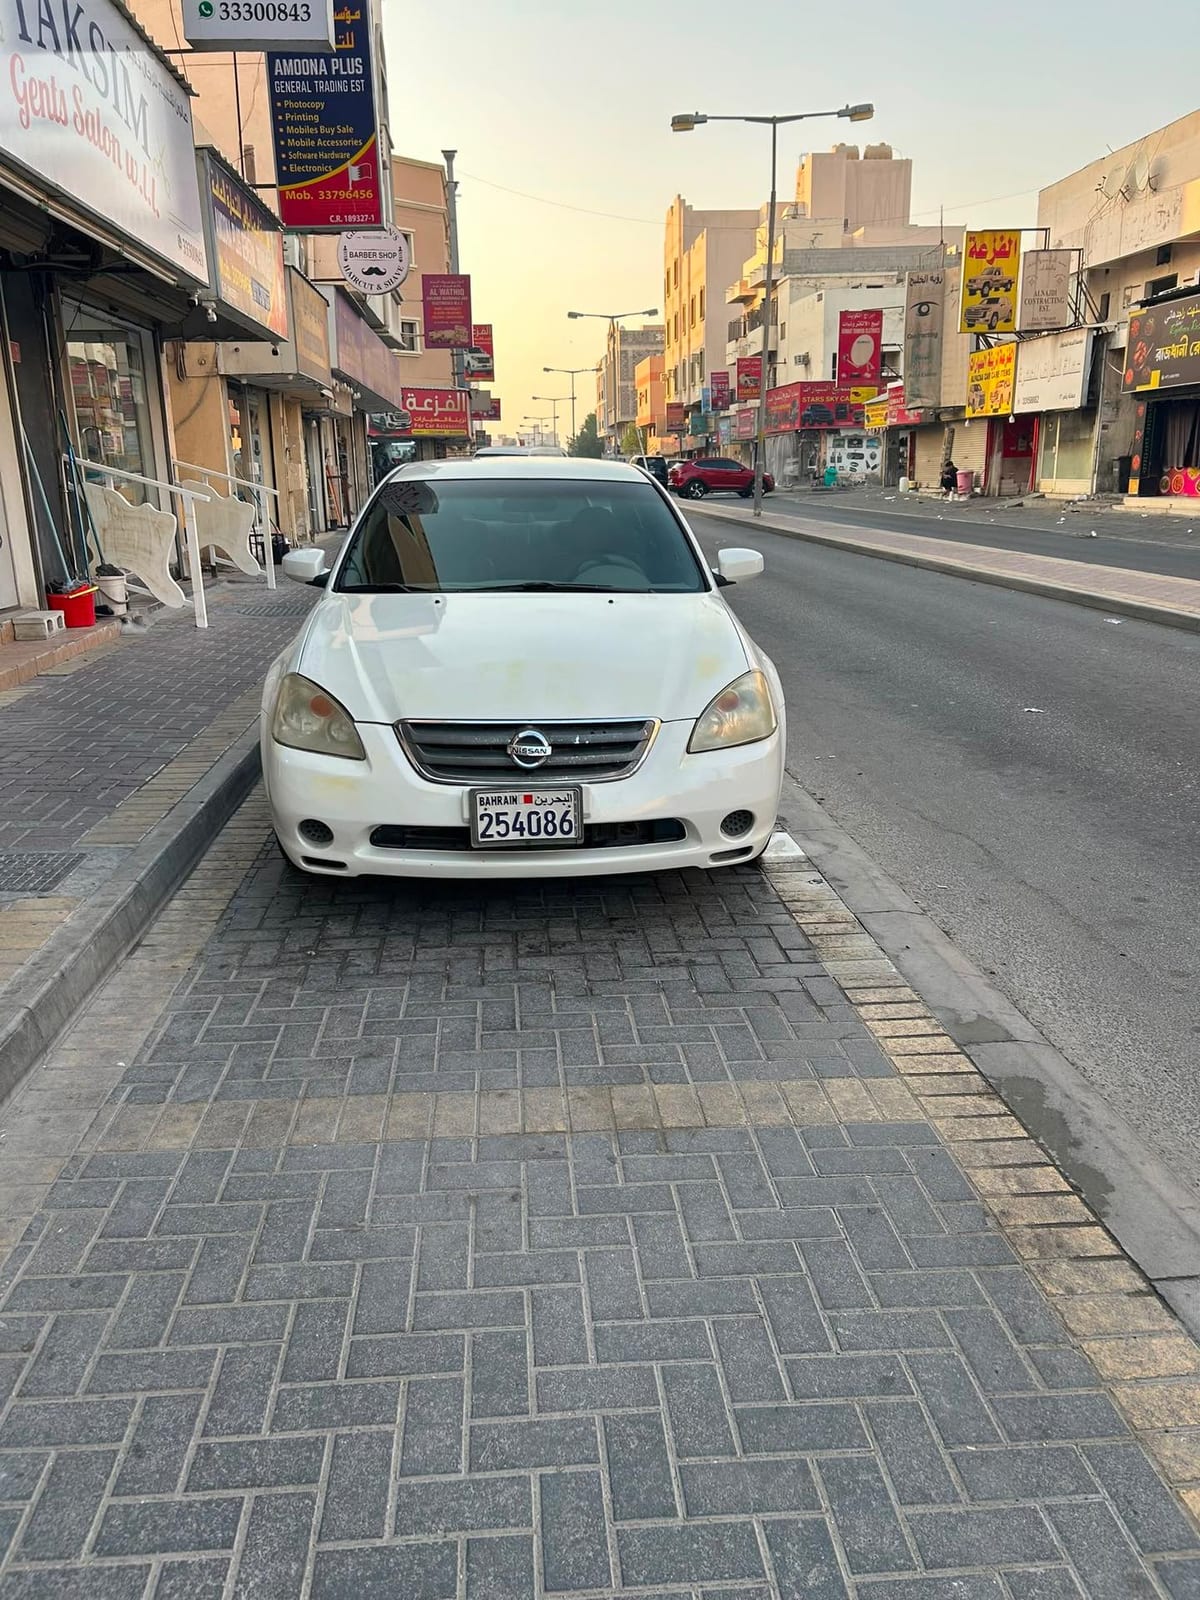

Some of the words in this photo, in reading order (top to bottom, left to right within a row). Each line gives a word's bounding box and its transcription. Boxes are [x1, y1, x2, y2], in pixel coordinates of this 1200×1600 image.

[219, 2, 311, 21] 33300843
[274, 59, 328, 75] AMOONA
[331, 58, 363, 75] PLUS
[274, 81, 312, 93] GENERAL
[314, 80, 349, 92] TRADING
[350, 80, 365, 92] EST
[10, 52, 69, 130] Gents
[72, 84, 122, 170] Salon
[284, 101, 325, 110] Photocopy
[285, 113, 320, 123] Printing
[286, 126, 318, 134] Mobiles
[320, 125, 335, 135] Buy
[336, 125, 354, 133] Sale
[287, 139, 315, 147] Mobile
[317, 138, 363, 146] Accessories
[288, 151, 318, 159] Software
[319, 150, 351, 159] Hardware
[289, 163, 333, 172] Electronics
[285, 190, 314, 200] Mob.
[318, 190, 374, 200] 33796456
[344, 214, 375, 222] 189327-1
[968, 234, 1017, 265] الفزعة
[348, 251, 377, 259] BARBER
[378, 252, 397, 260] SHOP
[343, 264, 374, 291] HAIRCUT
[376, 283, 382, 291] &
[383, 264, 404, 289] SHAVE
[406, 393, 466, 416] الفزعة
[512, 746, 547, 755] NISSAN
[479, 795, 518, 807] BAHRAIN
[534, 792, 573, 806] البحرين
[479, 809, 574, 839] 254086
